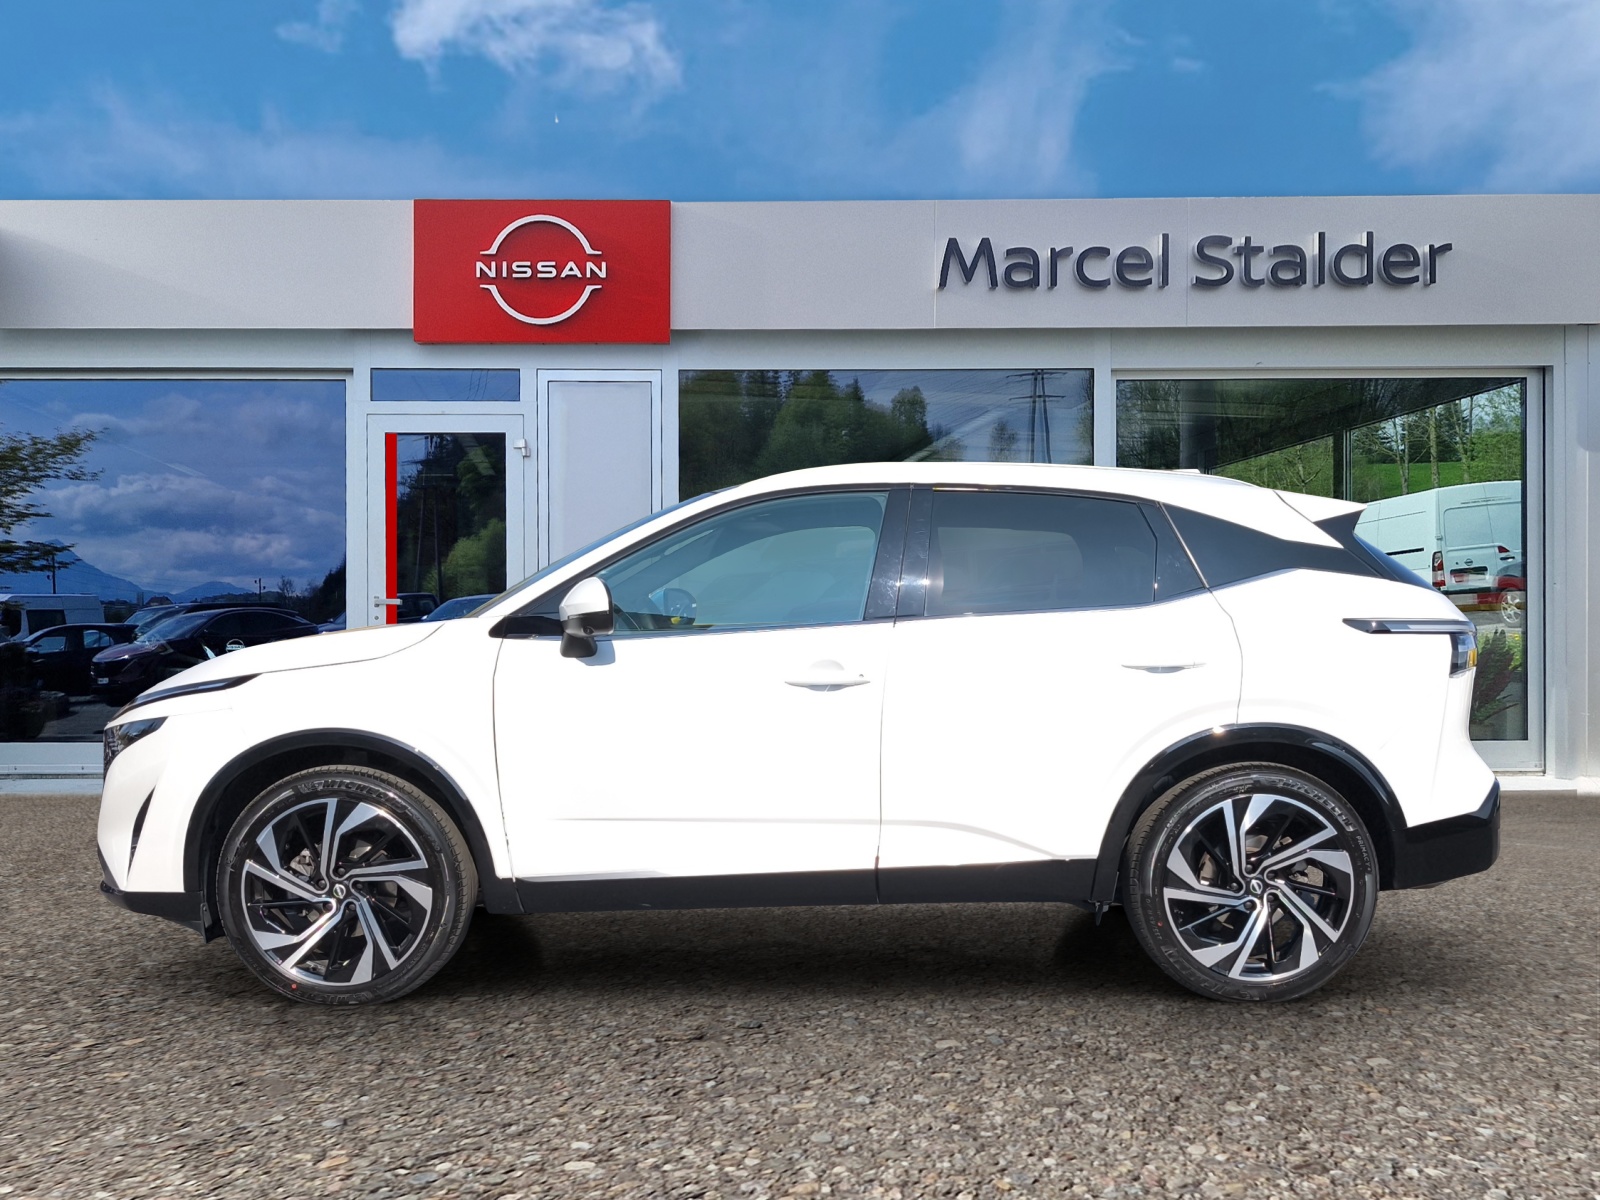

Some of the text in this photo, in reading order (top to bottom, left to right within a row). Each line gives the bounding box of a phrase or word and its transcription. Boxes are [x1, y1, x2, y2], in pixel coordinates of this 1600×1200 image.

[475, 260, 607, 279] NISSAN
[938, 230, 1453, 290] Marcel Stalder
[1355, 835, 1371, 867] PRIMACY
